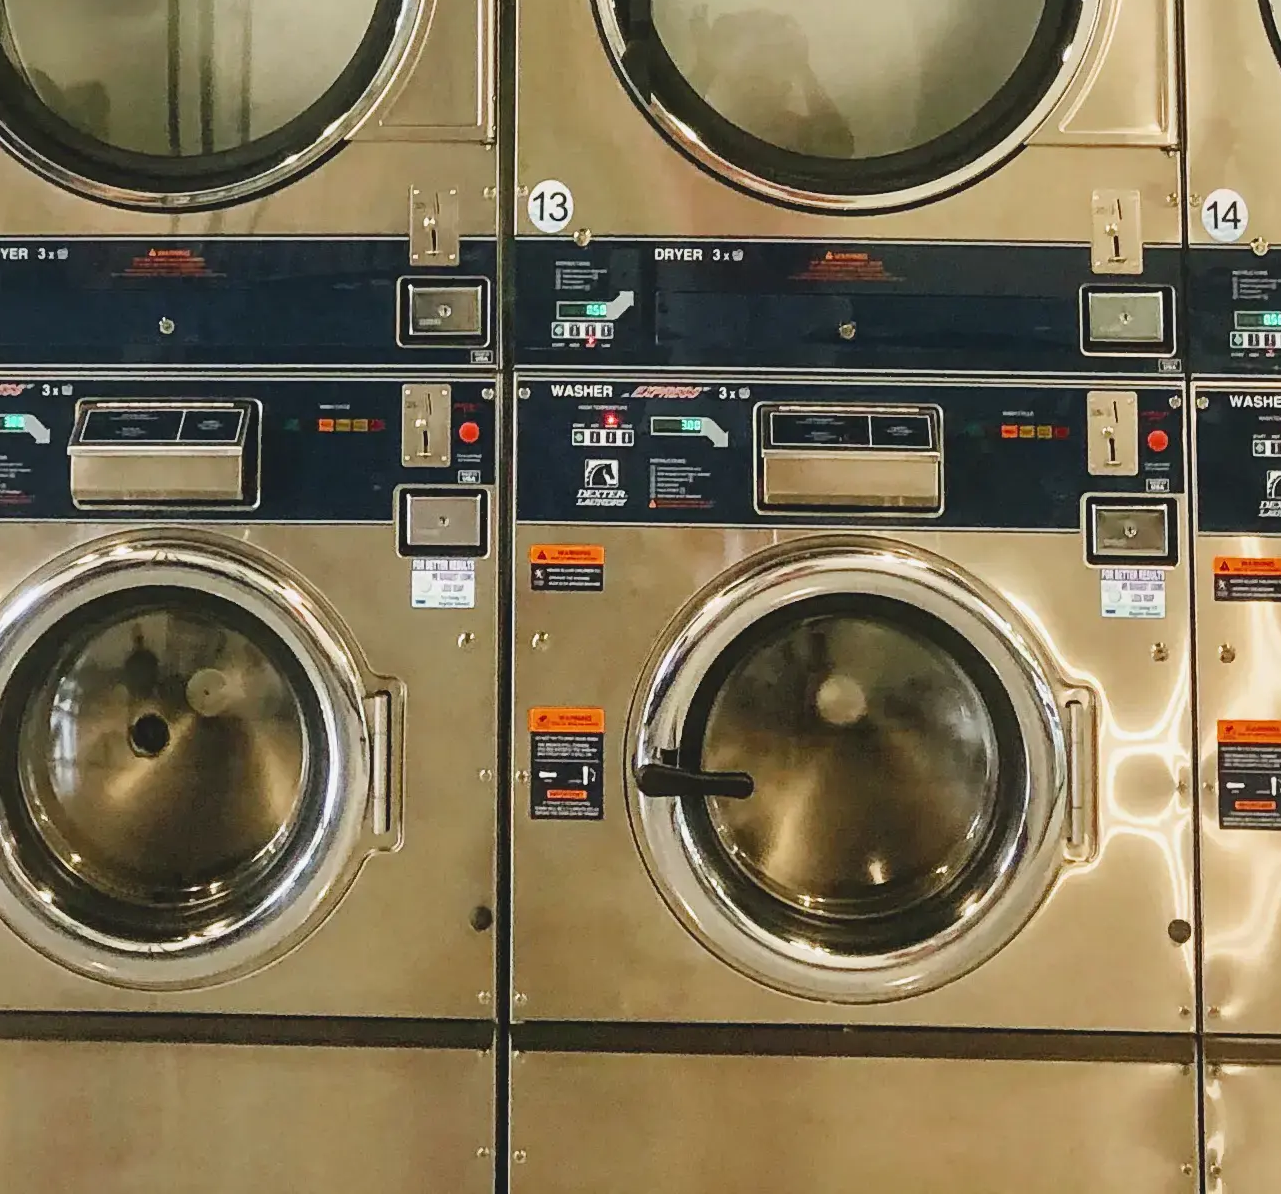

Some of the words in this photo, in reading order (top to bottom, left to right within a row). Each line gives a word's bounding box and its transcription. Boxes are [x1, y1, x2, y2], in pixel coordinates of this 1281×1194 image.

[532, 191, 568, 222] 13
[1206, 201, 1241, 230] 14
[654, 248, 703, 261] DRYER
[551, 384, 613, 398] WASHER
[576, 489, 628, 498] DEXTER
